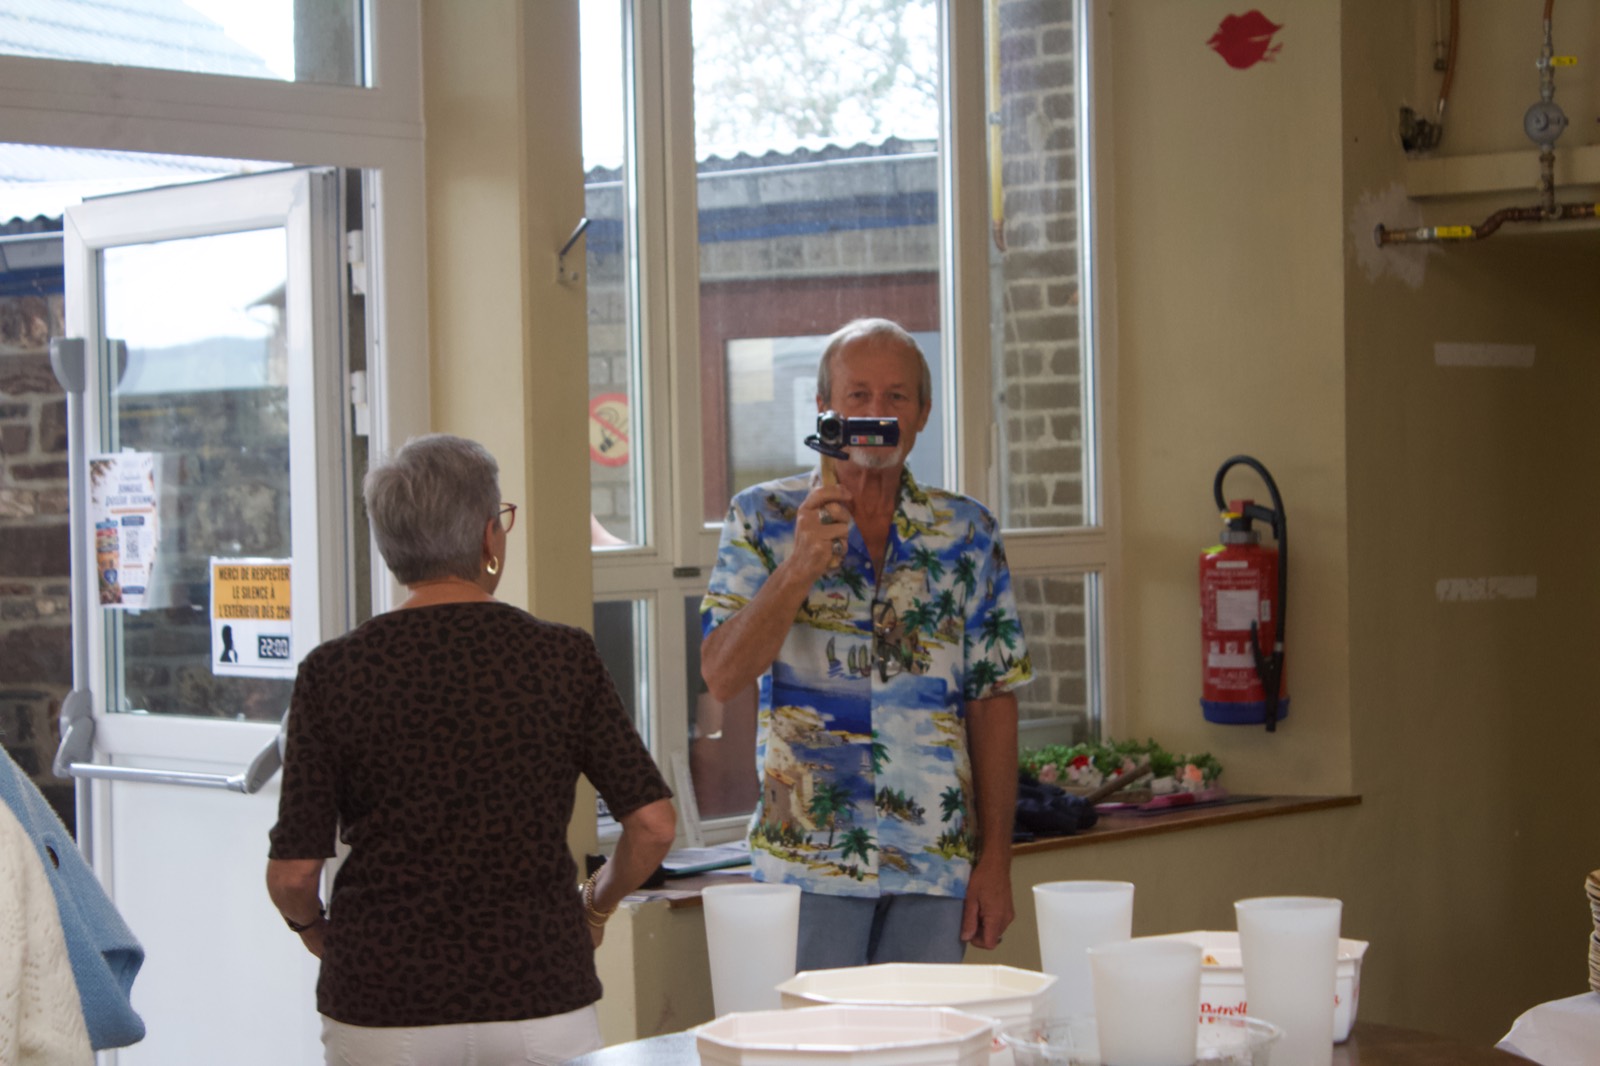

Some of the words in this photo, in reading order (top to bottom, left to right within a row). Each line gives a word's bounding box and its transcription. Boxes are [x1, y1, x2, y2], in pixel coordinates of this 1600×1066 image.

[219, 567, 239, 581] MERCI
[241, 567, 250, 581] DE
[252, 567, 290, 582] RESPECTER
[232, 586, 240, 599] LE
[242, 585, 268, 599] SILENCE
[260, 638, 288, 656] 22:00
